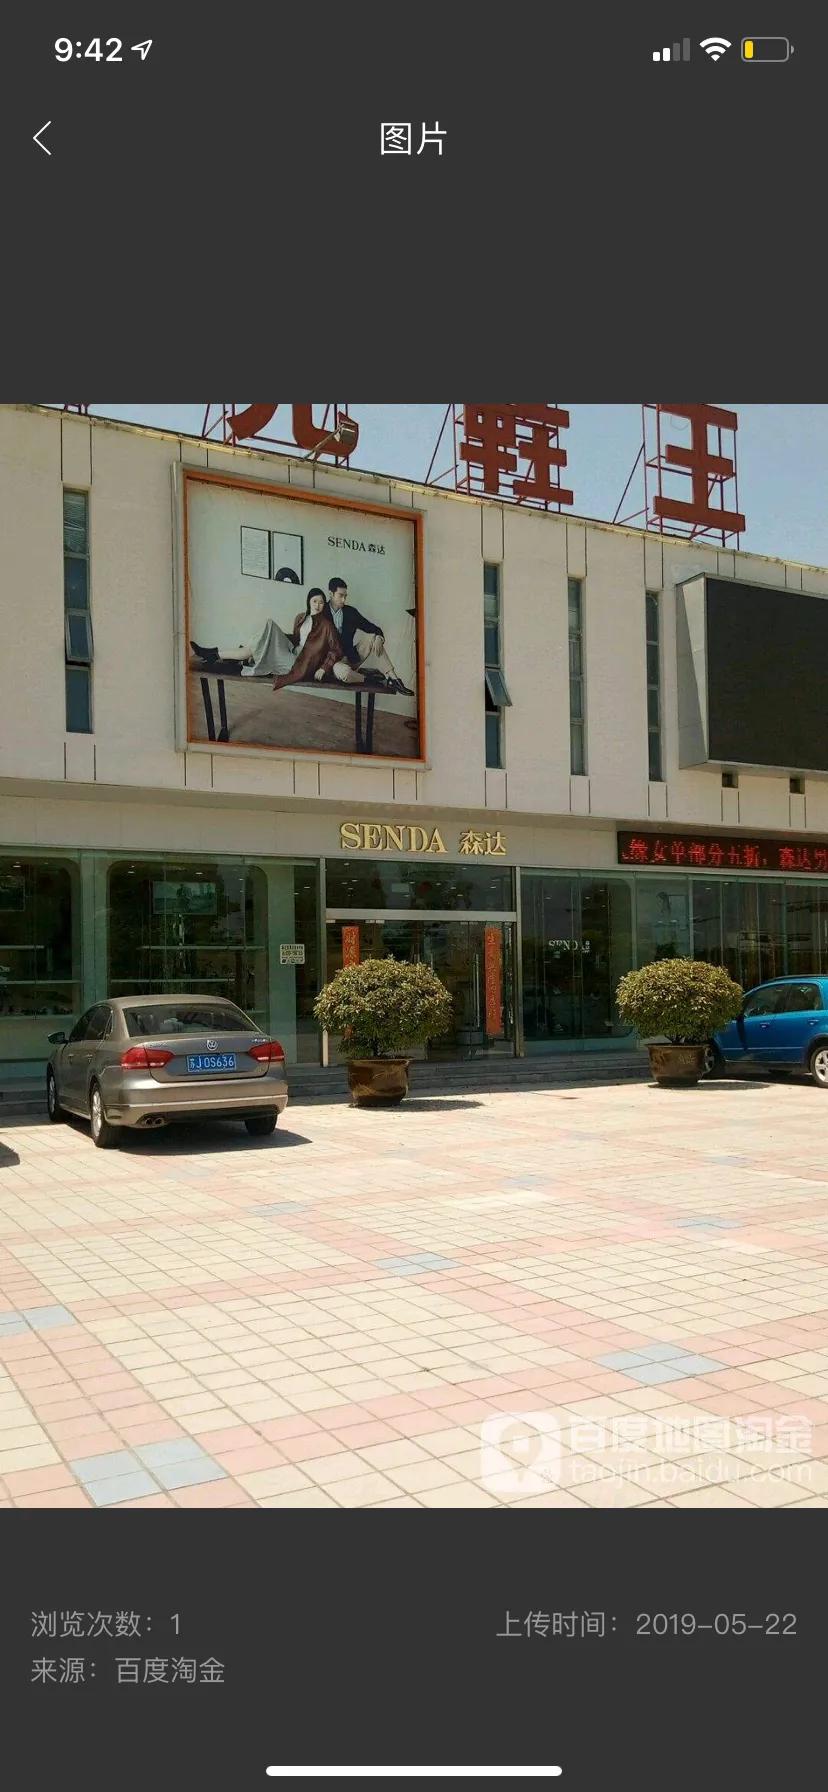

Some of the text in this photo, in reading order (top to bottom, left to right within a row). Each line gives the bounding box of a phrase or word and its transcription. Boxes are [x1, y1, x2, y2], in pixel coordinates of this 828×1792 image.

[327, 536, 367, 553] SENDA
[339, 822, 507, 857] SENDA 森达
